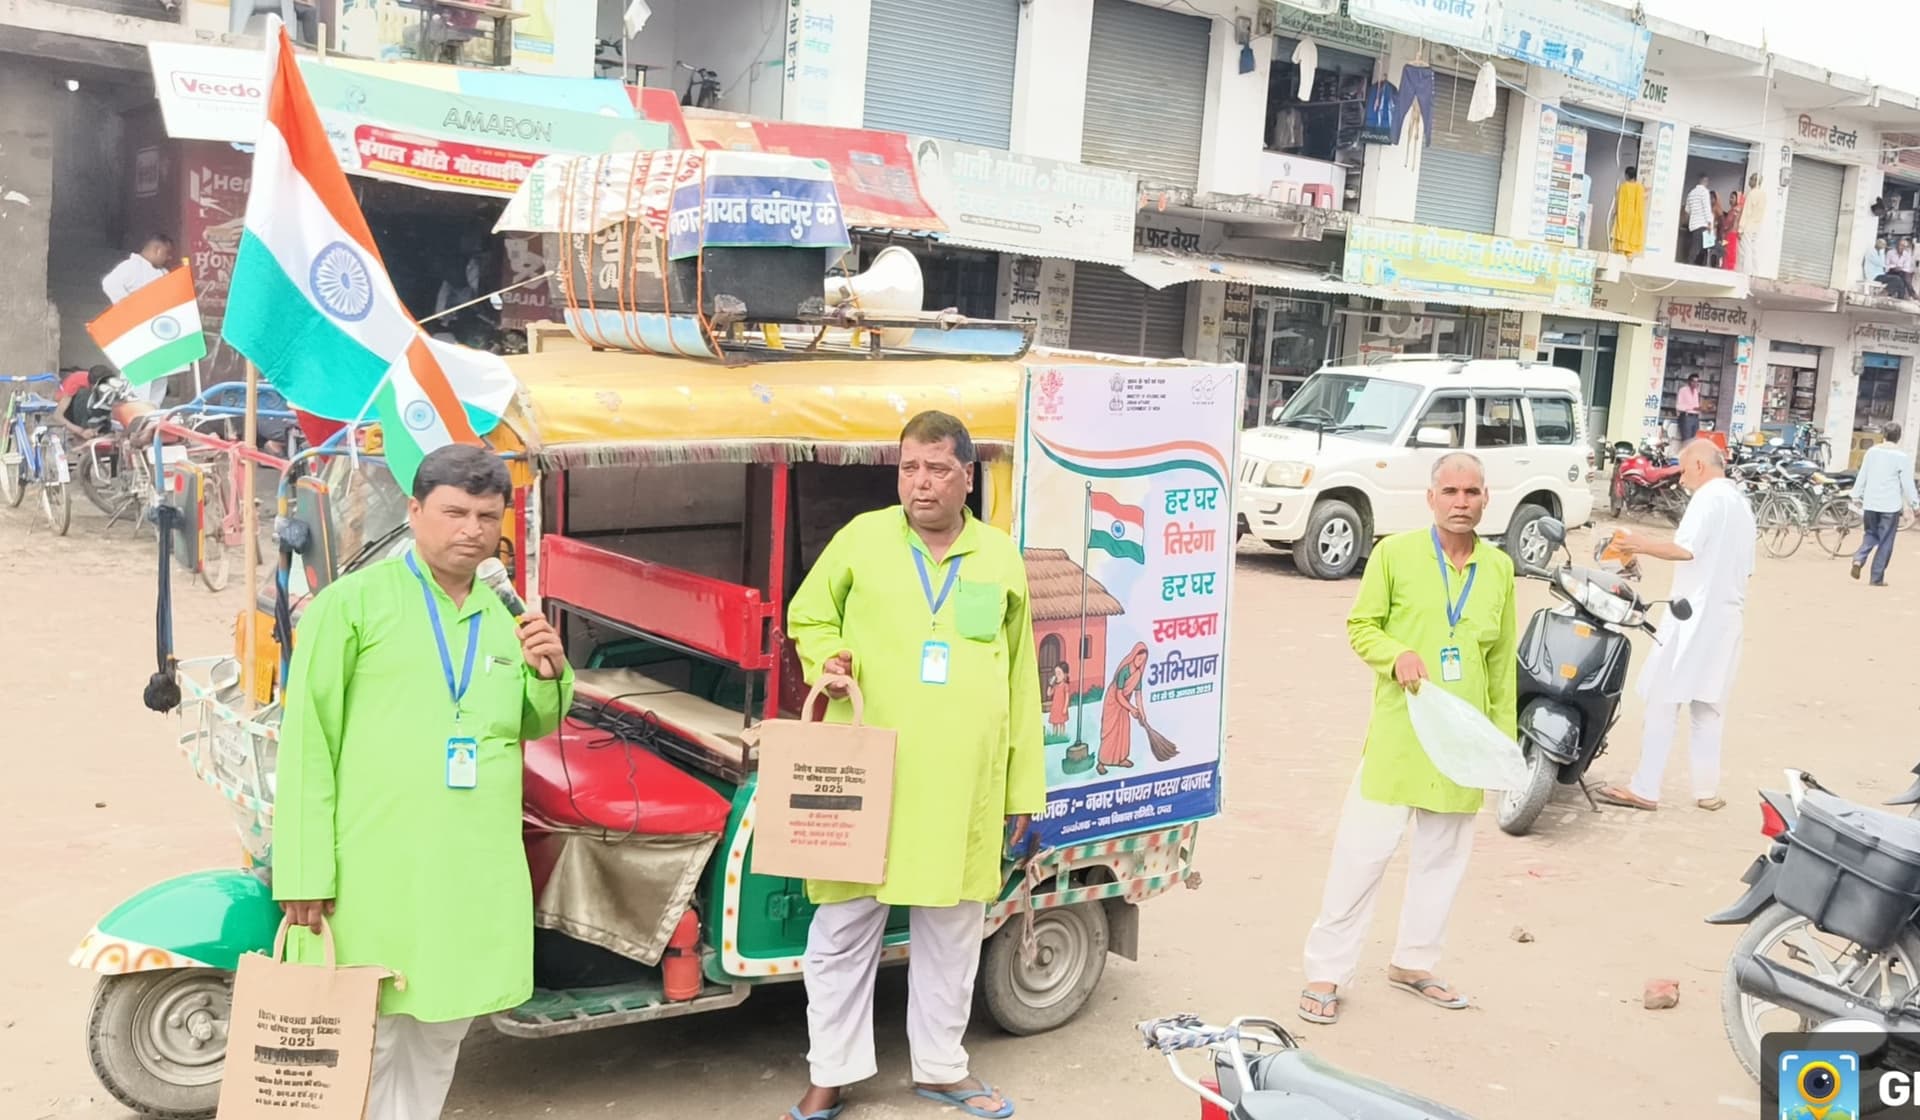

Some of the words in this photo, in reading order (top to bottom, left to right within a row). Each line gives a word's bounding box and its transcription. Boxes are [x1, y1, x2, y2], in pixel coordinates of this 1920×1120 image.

[180, 77, 261, 98] Veedo
[1642, 79, 1668, 104] ZONE
[443, 107, 552, 142] AMARON
[214, 173, 251, 194] Her
[750, 190, 813, 240] बसंतपुर
[815, 194, 838, 226] के
[1667, 303, 1692, 323] कपूर
[1728, 306, 1748, 325] स्टोर
[1165, 489, 1191, 514] हर
[1194, 487, 1218, 510] घर
[1163, 522, 1216, 556] तिरंगा
[1162, 574, 1188, 601] हर
[1192, 572, 1216, 595] घर
[1153, 613, 1218, 643] स्वच्छता
[1148, 650, 1219, 686] अभियान
[814, 784, 843, 793] 2025
[1085, 791, 1113, 811] नगर
[1115, 781, 1151, 805] पंचायत
[1154, 775, 1181, 796] परसा
[1181, 770, 1213, 791] बाजार
[280, 1036, 315, 1046] 2025
